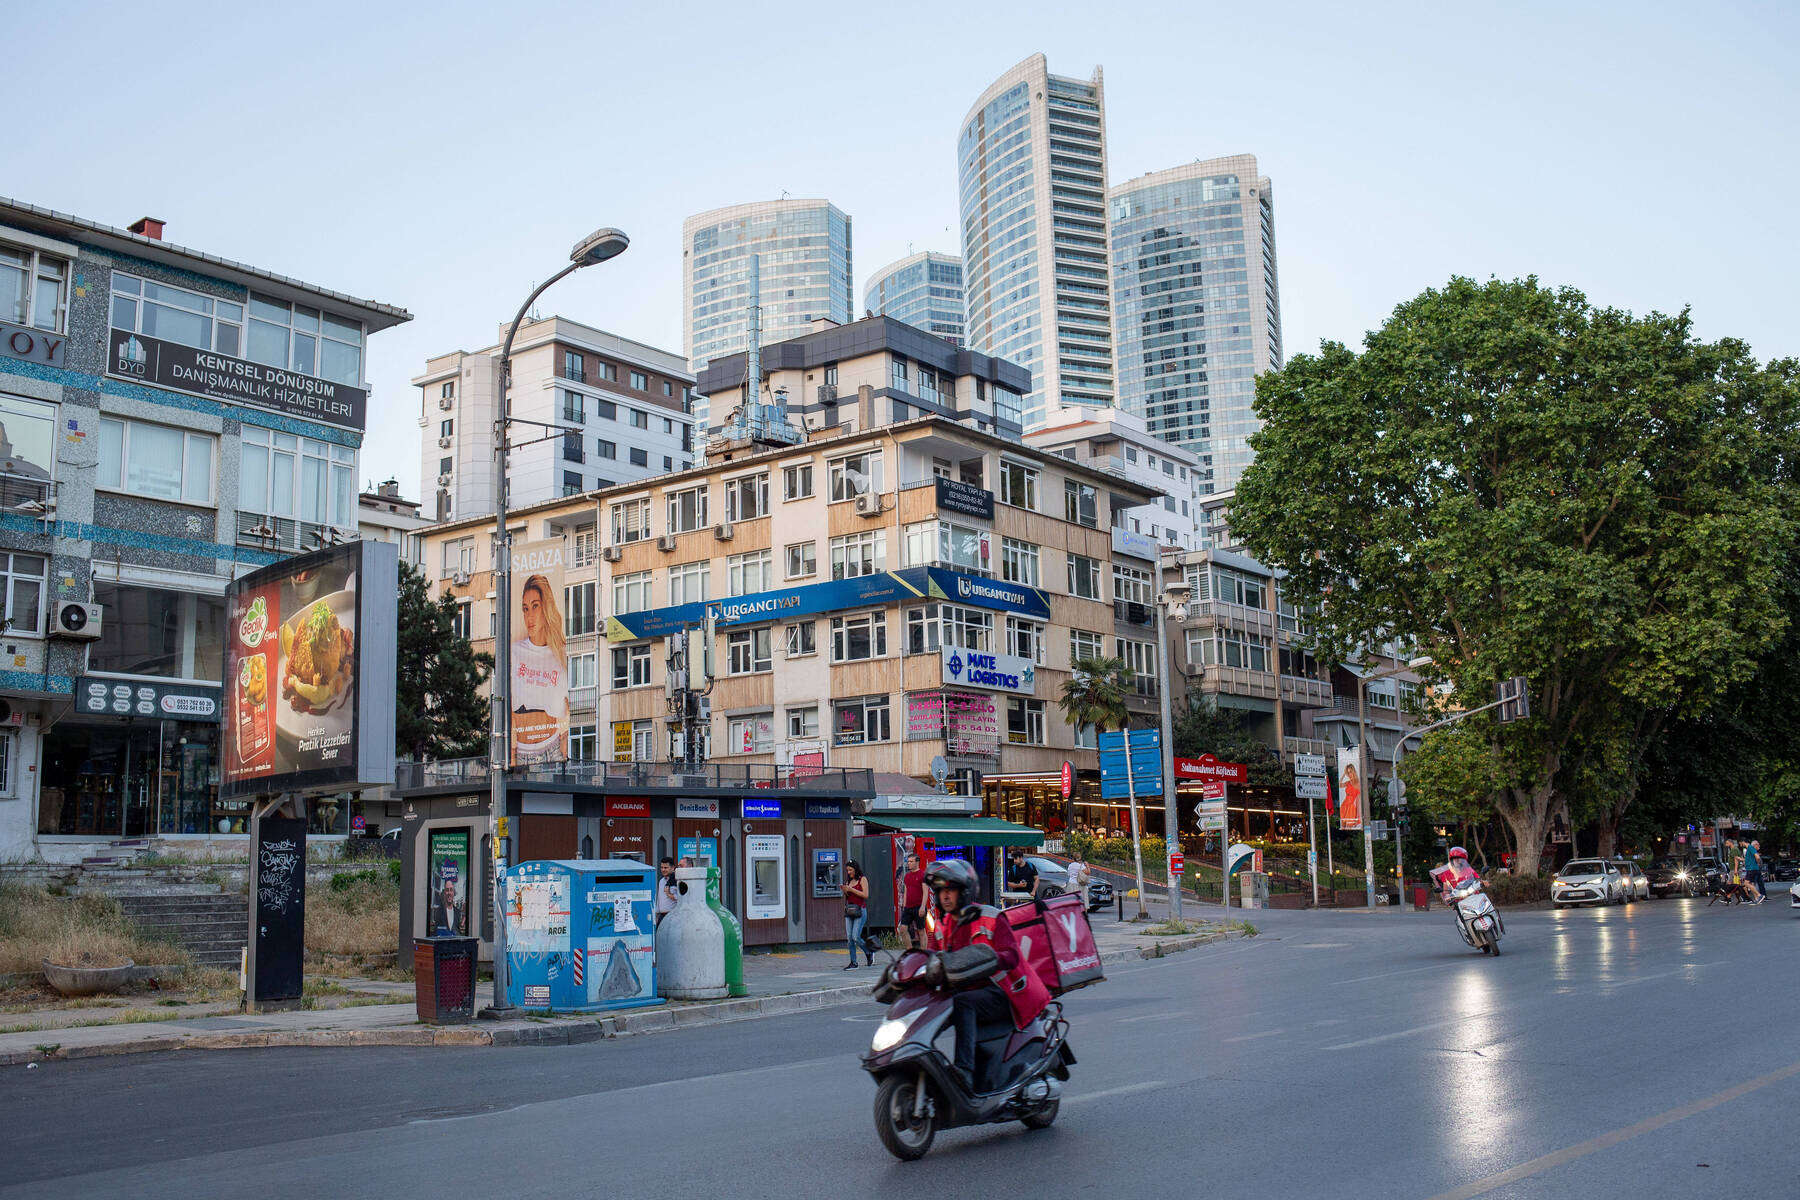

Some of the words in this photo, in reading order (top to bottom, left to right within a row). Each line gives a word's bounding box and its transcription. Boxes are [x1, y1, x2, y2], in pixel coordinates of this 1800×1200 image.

[0, 328, 62, 360] OY
[118, 359, 146, 375] DYD
[196, 353, 265, 381] KENTSEL
[266, 370, 335, 398] DÖNÜŞÜM
[172, 364, 270, 399] DANIŞMANLIK
[274, 387, 353, 417] HİZMETLERİ
[950, 481, 967, 493] ROYAL
[511, 548, 563, 573] SAGAZA
[967, 653, 997, 671] MATE
[967, 668, 1019, 689] LOGISTICS
[969, 724, 982, 732] 54
[298, 737, 319, 753] Pratik
[319, 731, 351, 749] Lezzetleri
[321, 748, 339, 760] Sever
[1181, 762, 1215, 775] Sultanahmet
[1215, 766, 1238, 777] Köftecisi
[679, 803, 708, 812] DenizBank
